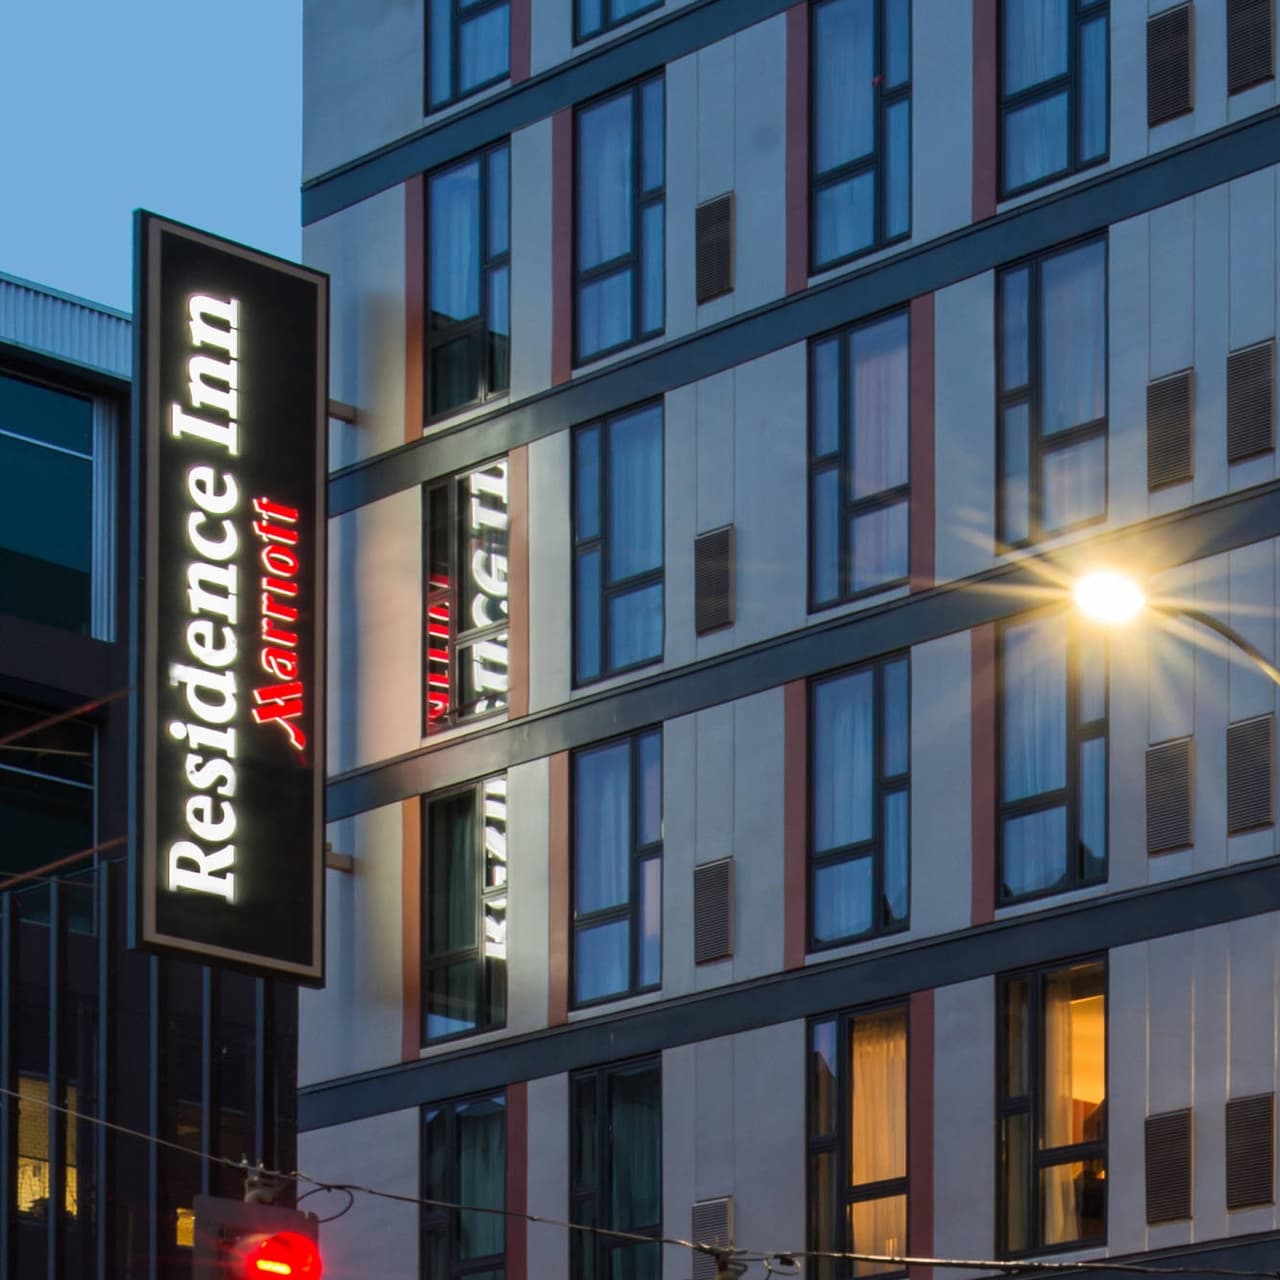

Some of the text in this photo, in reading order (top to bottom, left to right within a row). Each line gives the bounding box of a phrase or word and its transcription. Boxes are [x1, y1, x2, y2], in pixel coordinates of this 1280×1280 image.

[168, 293, 240, 904] Residence Inn
[251, 496, 307, 752] Marriott
